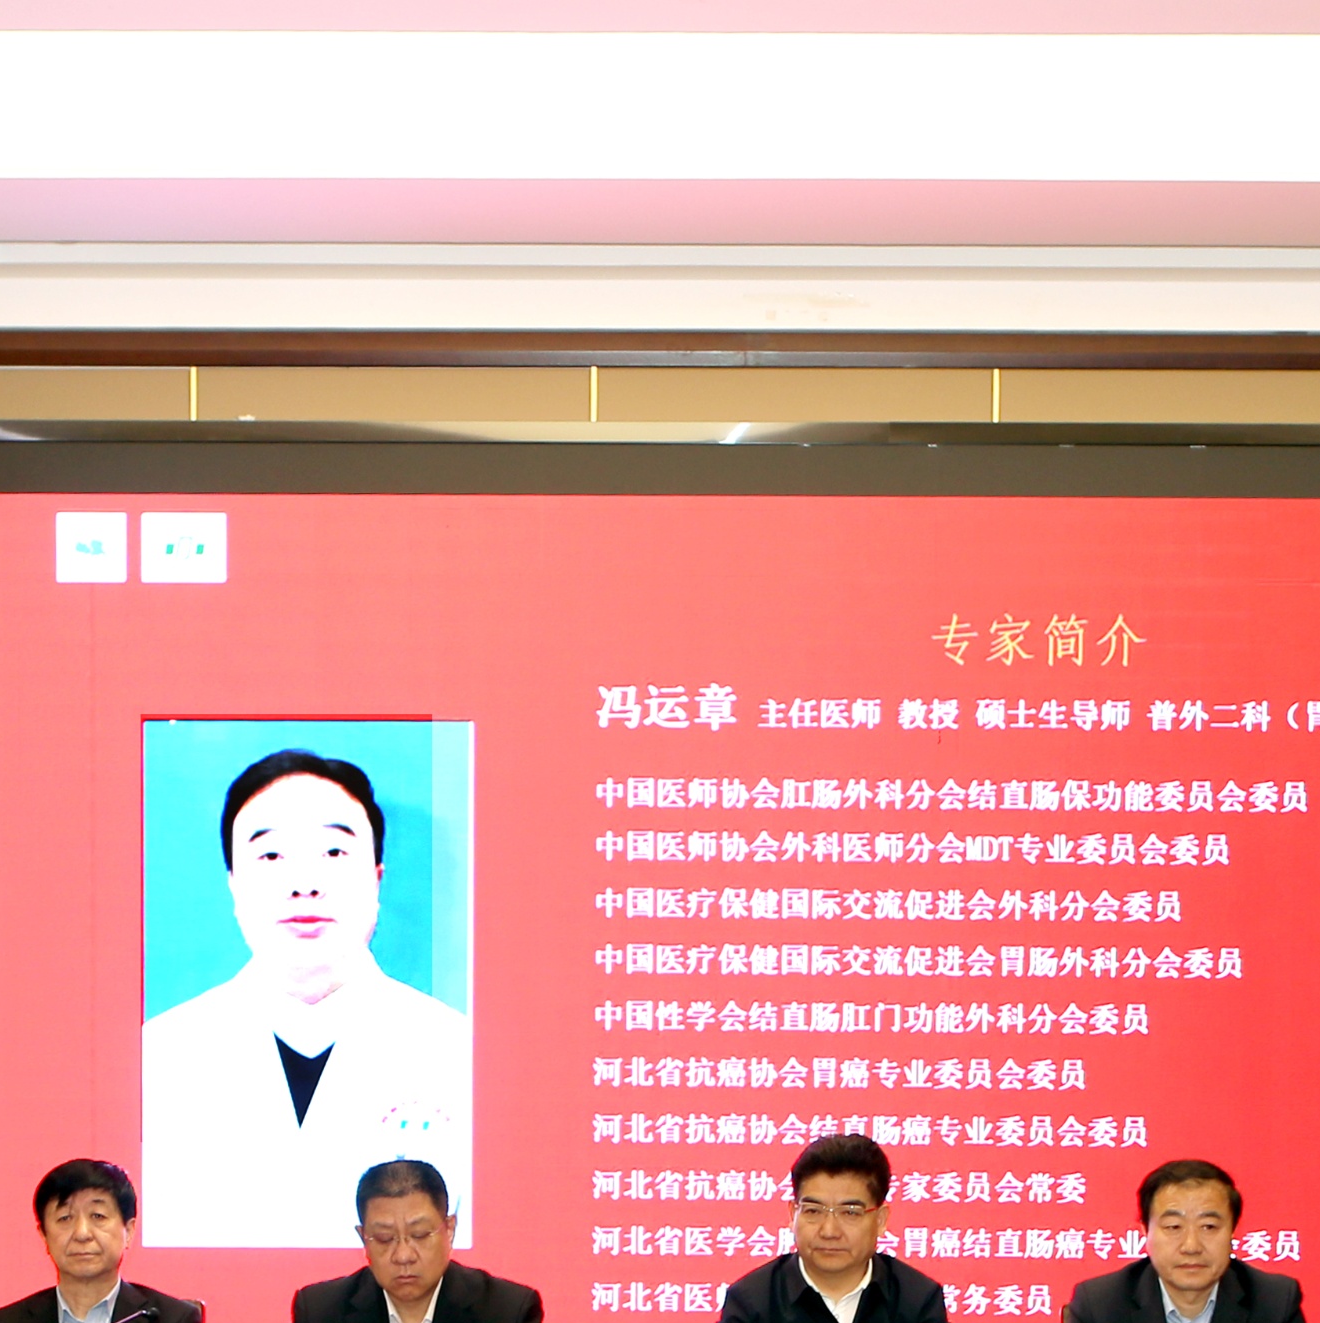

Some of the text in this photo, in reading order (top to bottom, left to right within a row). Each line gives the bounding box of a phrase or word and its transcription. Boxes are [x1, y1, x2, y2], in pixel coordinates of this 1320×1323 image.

[932, 613, 1147, 667] 专家简介
[595, 682, 737, 732] 冯运章
[757, 697, 881, 731] 主任医师
[897, 698, 960, 731] 教授
[975, 698, 1132, 733] 硕士生导师
[594, 776, 1309, 814] 中国医师协会肛肠外科分会结直肠保功能委员会委员
[594, 829, 1231, 867] 中国医师协会外科医师分会MDT专业委员会委员
[594, 885, 1183, 924] 中国医疗保健国际交流促进会外科分会委员
[594, 942, 1244, 980] 中国医疗保健国际交流促进会胃肠外科分会委员
[593, 998, 1150, 1036] 中国性学会结直肠肛门功能外科分会委员
[591, 1055, 1087, 1092] 河北省抗癌协会胃癌专业委员会委员
[591, 1112, 1149, 1149] 河北省抗癌协会结直肠癌专业委员会委员
